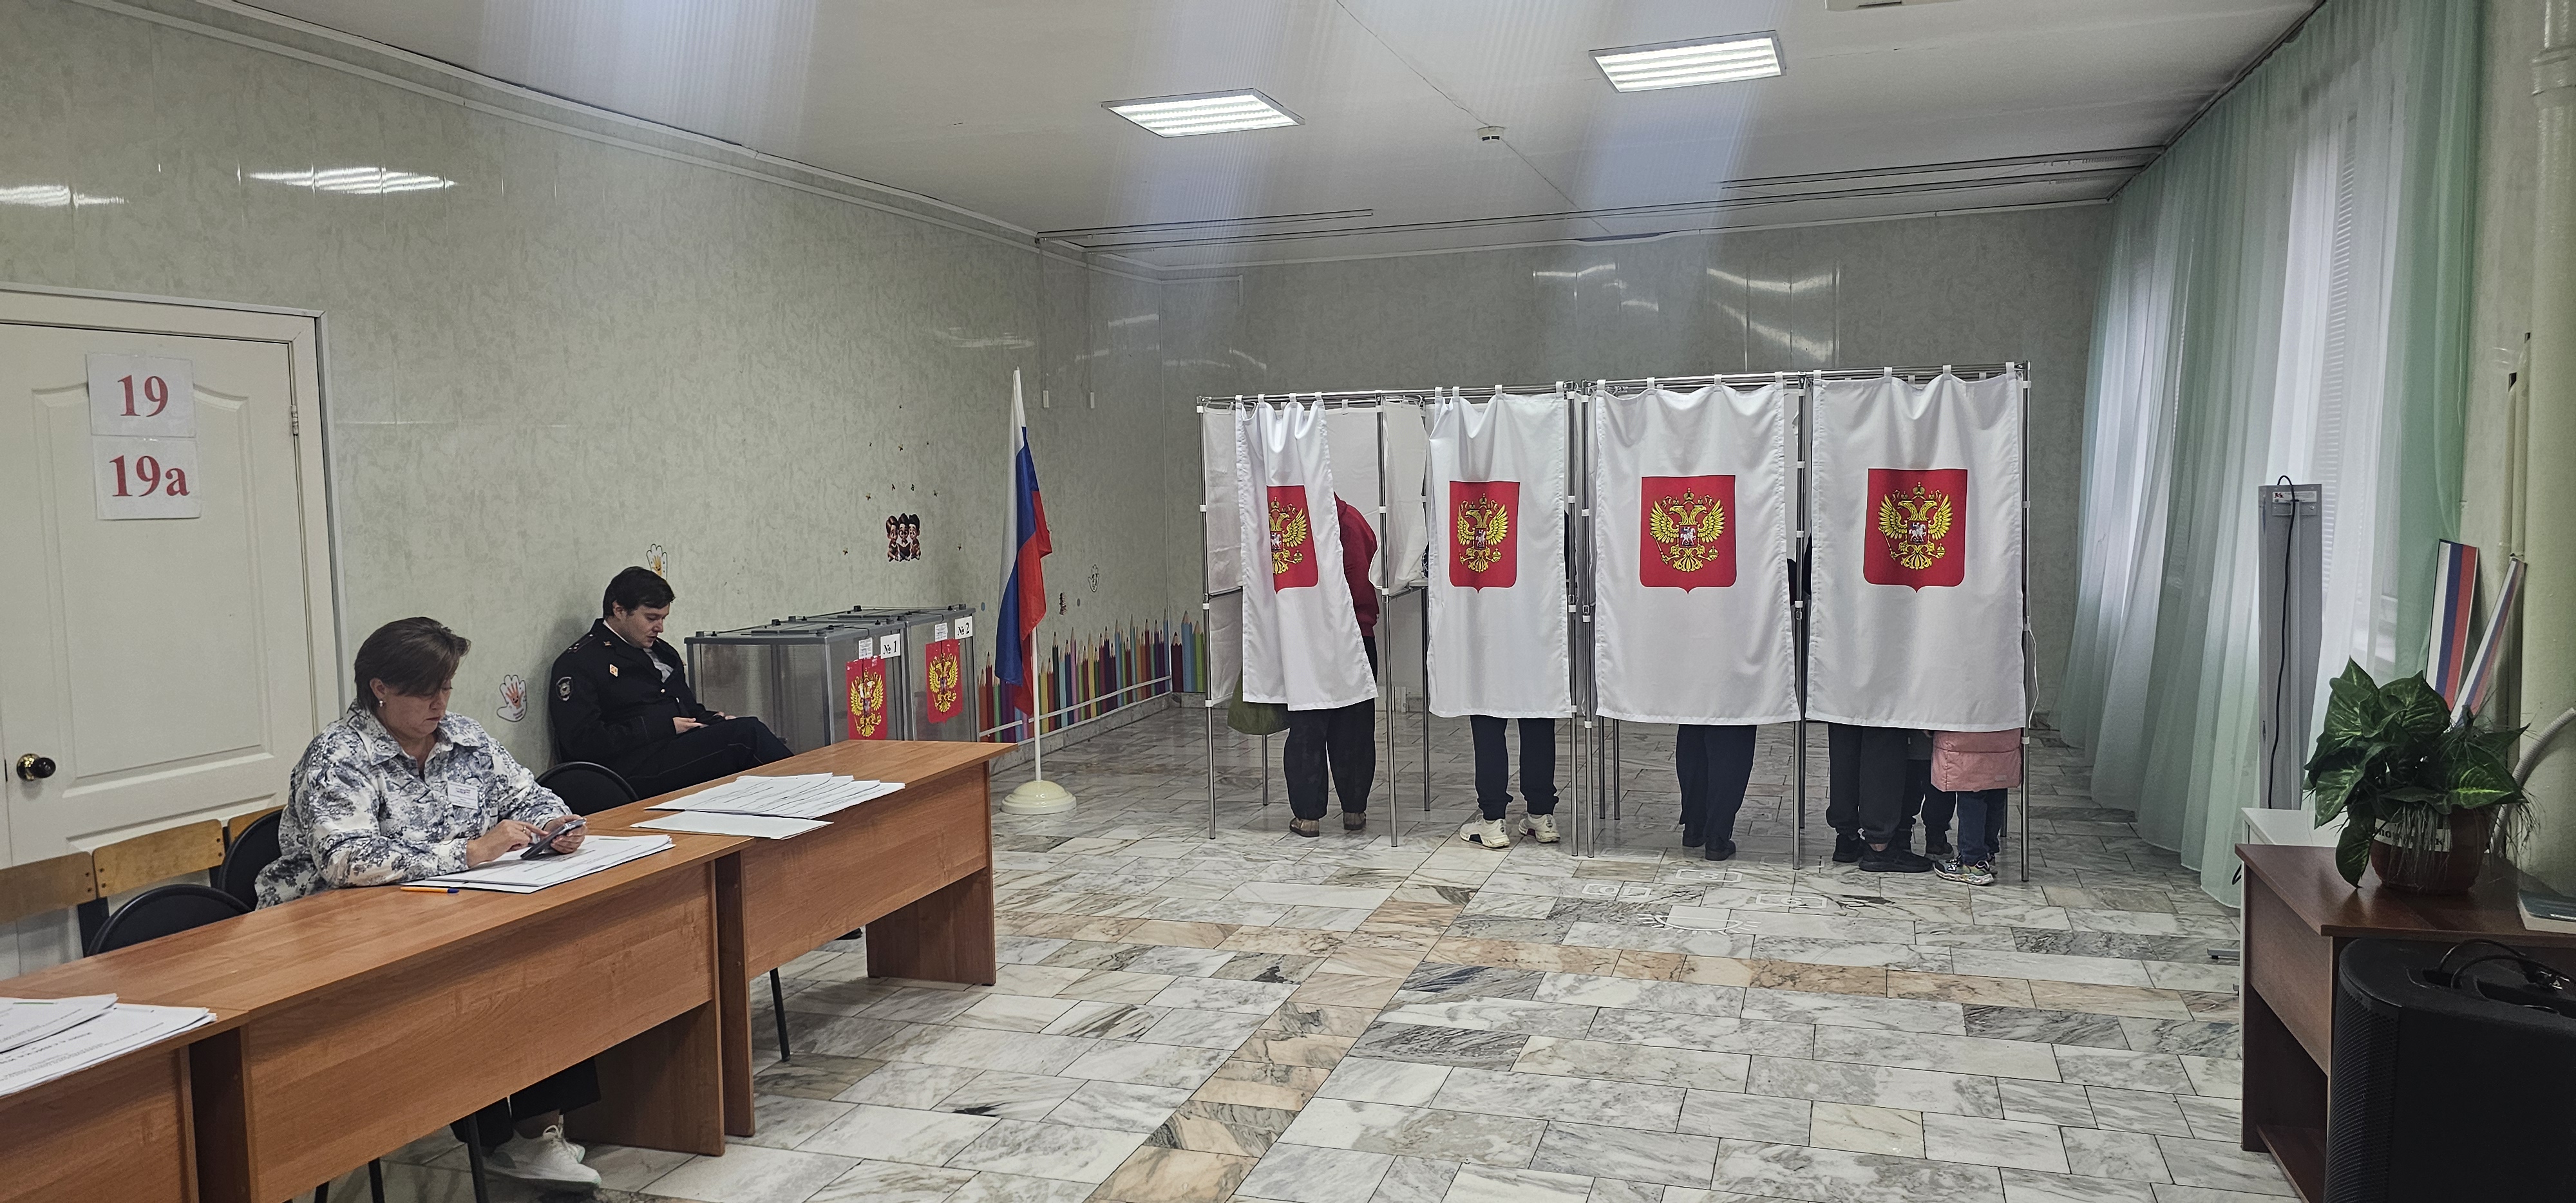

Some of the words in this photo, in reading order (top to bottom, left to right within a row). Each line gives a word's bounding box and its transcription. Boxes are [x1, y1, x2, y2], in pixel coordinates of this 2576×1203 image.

[117, 374, 169, 417] 19
[109, 455, 191, 498] 19а
[957, 626, 965, 636] №
[965, 622, 970, 634] 2
[883, 644, 891, 655] №
[893, 640, 897, 653] 1
